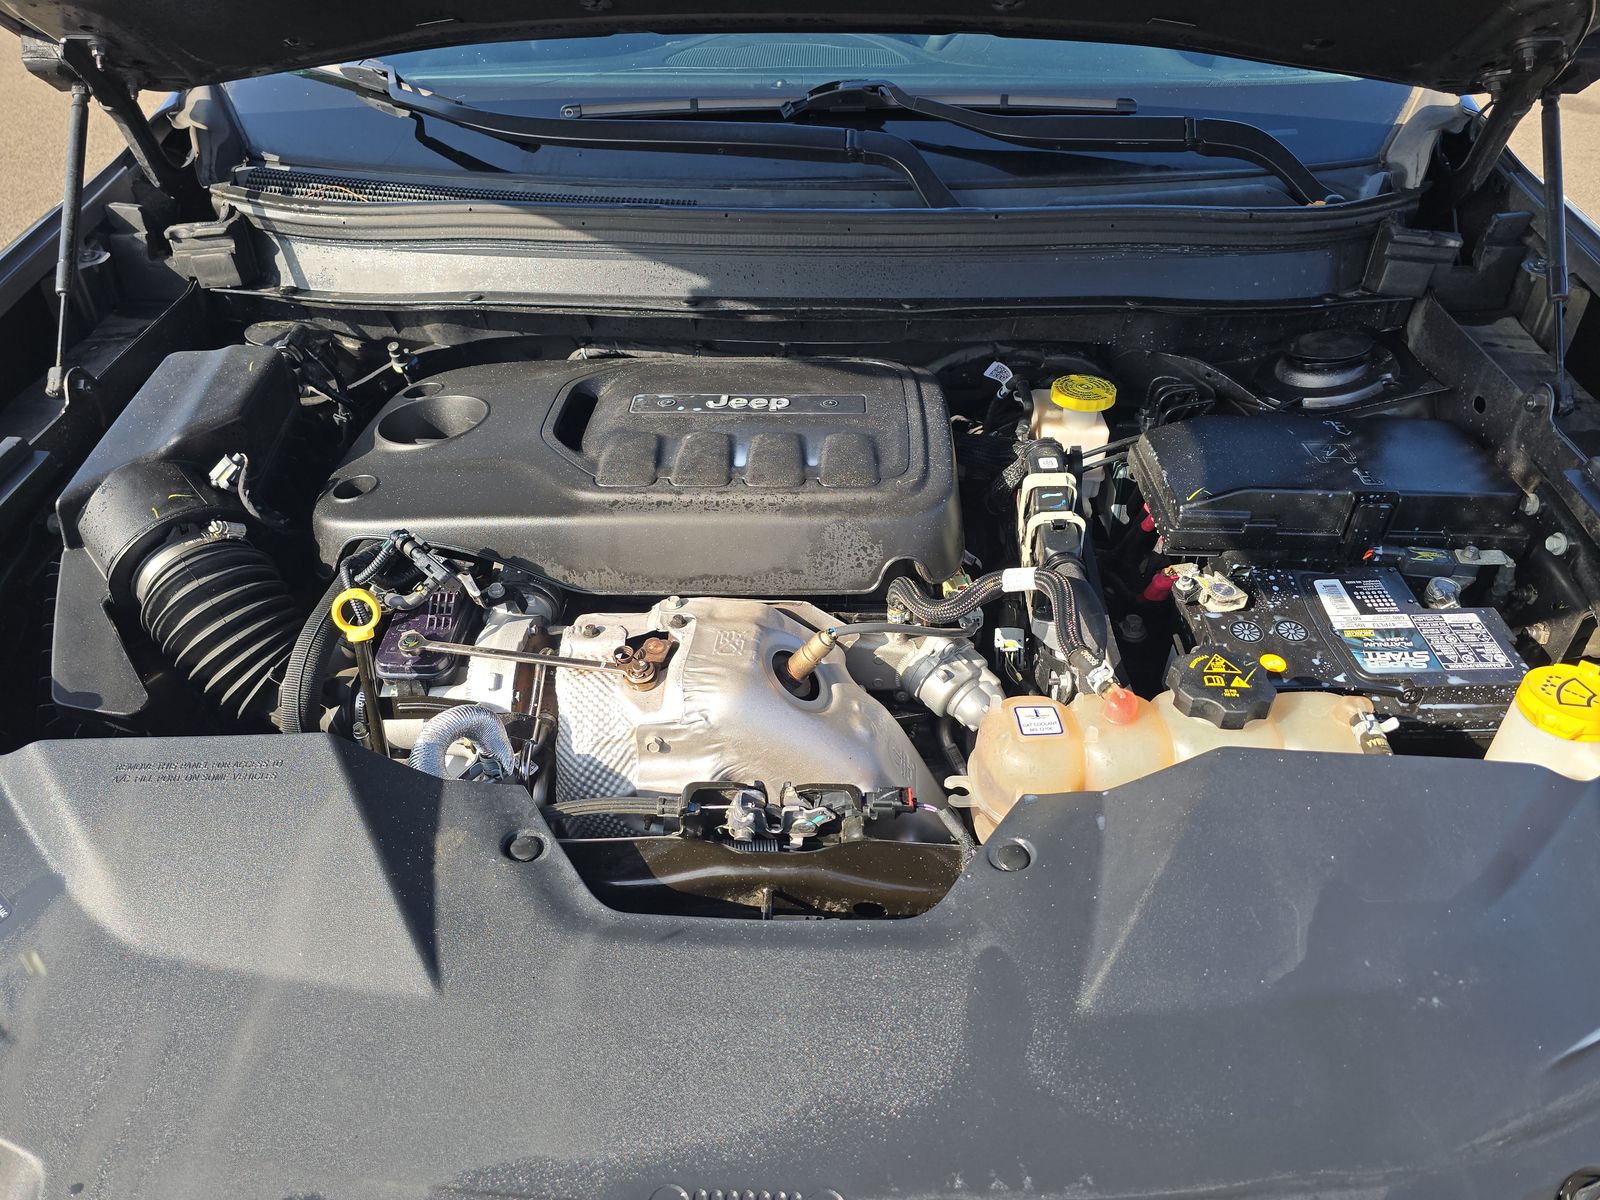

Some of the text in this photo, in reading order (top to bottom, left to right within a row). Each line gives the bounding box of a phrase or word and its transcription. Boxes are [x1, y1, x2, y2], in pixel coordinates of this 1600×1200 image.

[706, 394, 790, 411] Jeep
[1363, 650, 1430, 661] START
[1365, 660, 1428, 668] SUPER
[115, 762, 153, 771] REMOVE
[232, 760, 269, 769] ACCESS
[201, 773, 227, 781] SOME
[232, 772, 278, 781] VEHICLES
